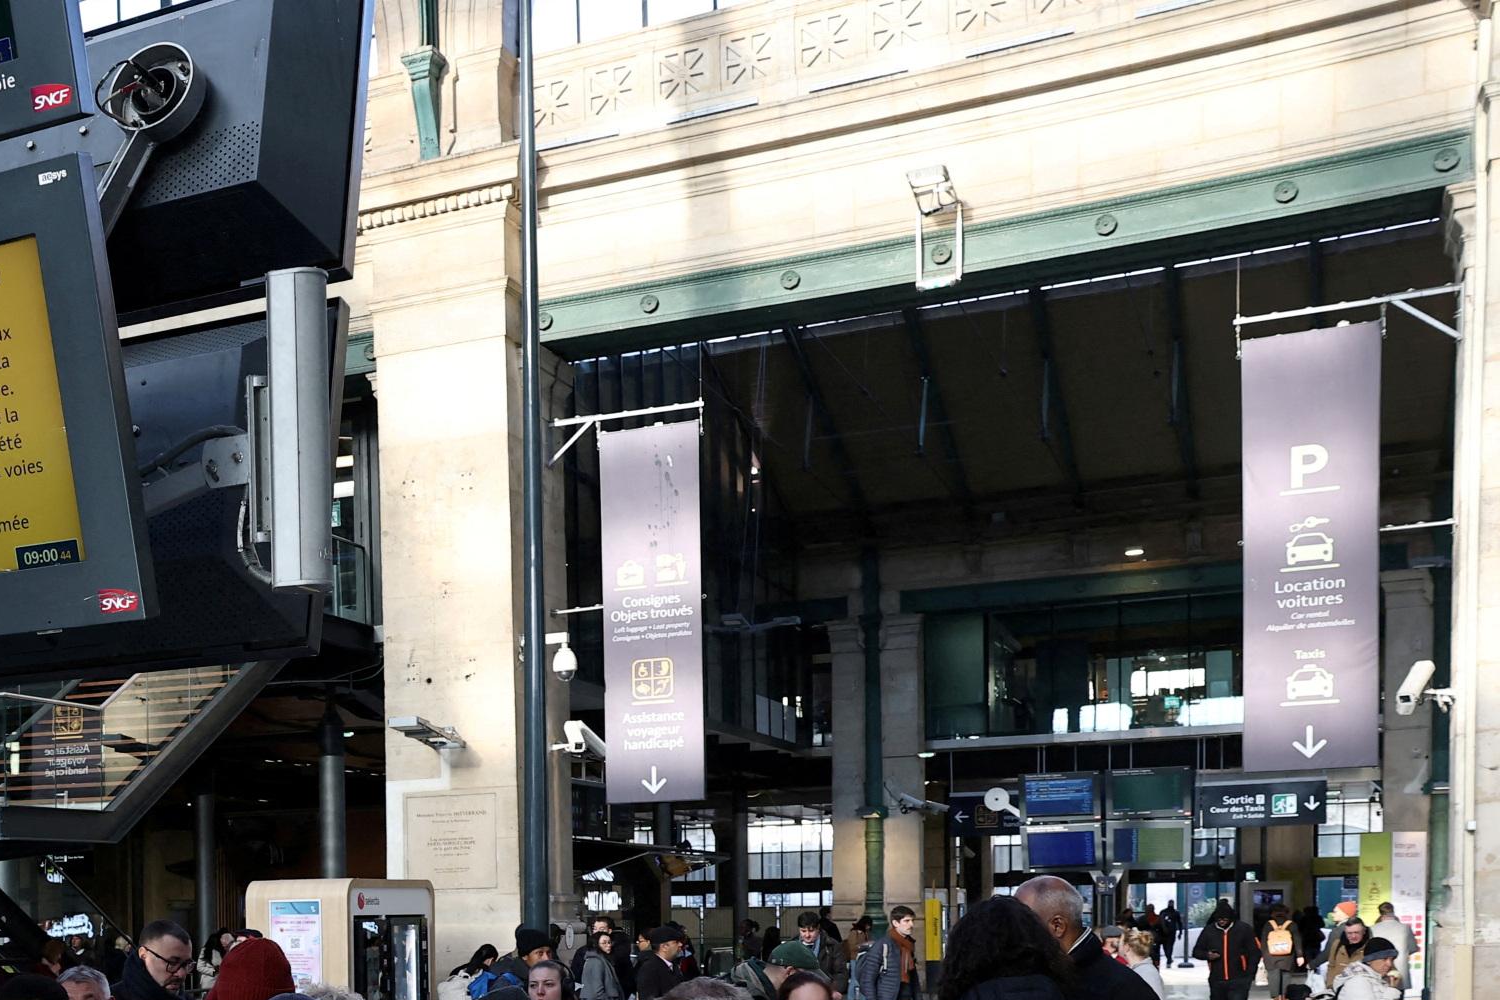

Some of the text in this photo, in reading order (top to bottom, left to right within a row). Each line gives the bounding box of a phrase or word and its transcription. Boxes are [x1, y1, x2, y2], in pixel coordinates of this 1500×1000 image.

[33, 87, 70, 110] SNCF
[5, 407, 19, 424] la
[4, 458, 43, 477] voies
[1289, 444, 1329, 489] P
[23, 548, 71, 565] 09:00 44
[1274, 577, 1346, 594] Location
[100, 596, 136, 612] SNCF
[622, 594, 681, 608] Consignes
[1276, 594, 1344, 609] voitures
[611, 604, 694, 624] Objets trouvés
[1293, 648, 1326, 660] Taxis
[623, 711, 685, 724] Assistance
[627, 725, 681, 739] voyageur
[624, 736, 685, 751] handicapé
[1222, 794, 1255, 805] Sortie
[1210, 804, 1265, 814] Cour des Taxis
